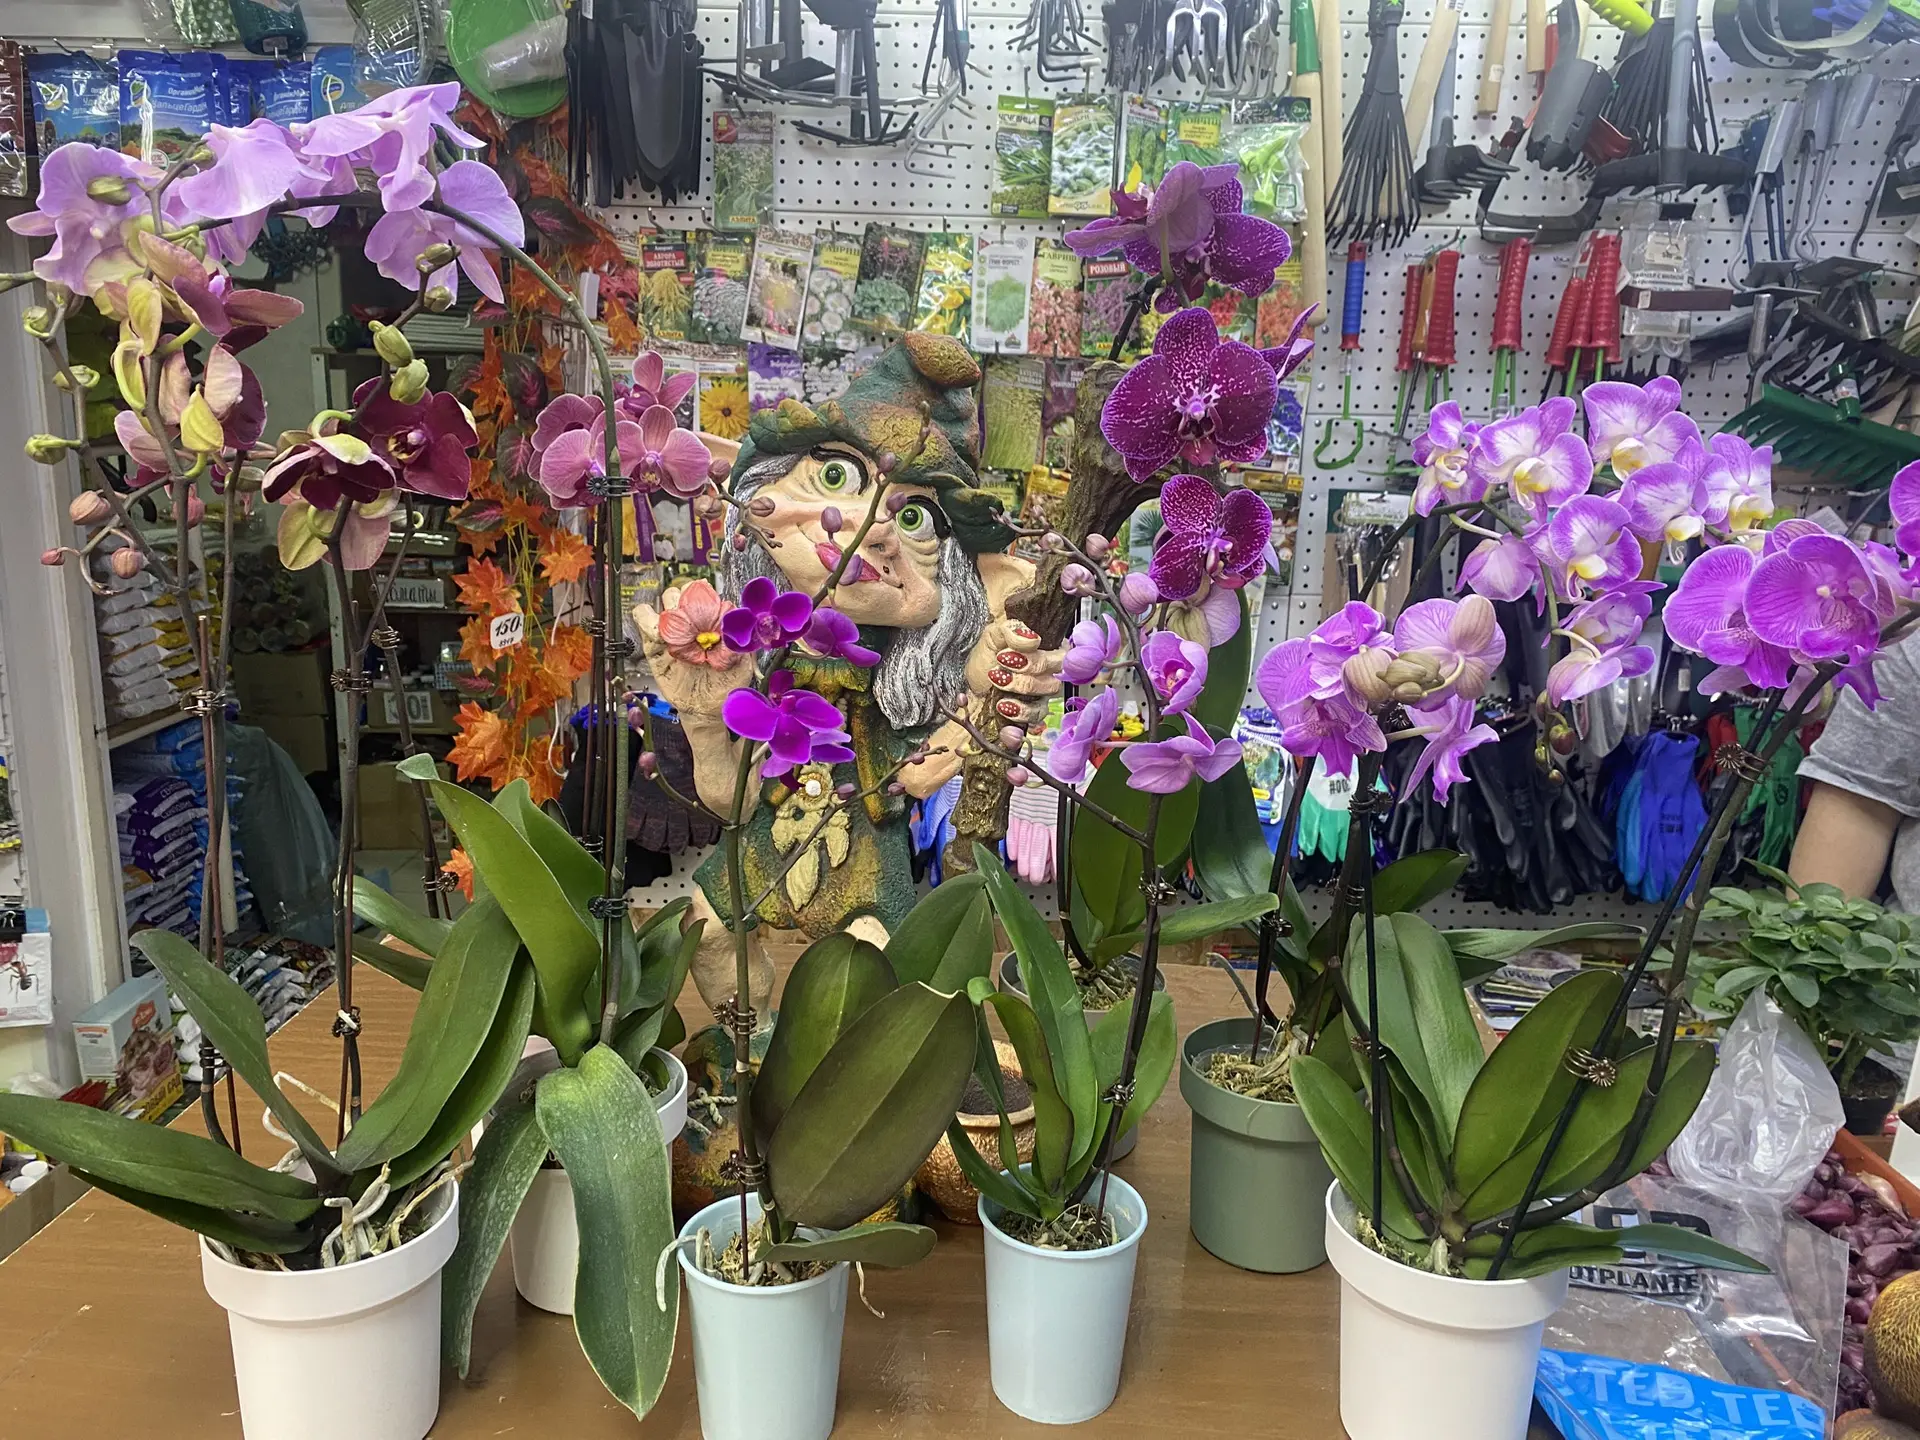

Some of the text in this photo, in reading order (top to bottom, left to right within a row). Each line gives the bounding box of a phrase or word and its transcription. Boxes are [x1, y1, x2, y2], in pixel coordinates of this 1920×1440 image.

[730, 215, 757, 224] АЭЛИТА
[1090, 263, 1126, 275] РОЗОВЫЙ
[657, 329, 684, 338] АЭЛИТА
[1569, 1264, 1720, 1293] OTPLANTEN
